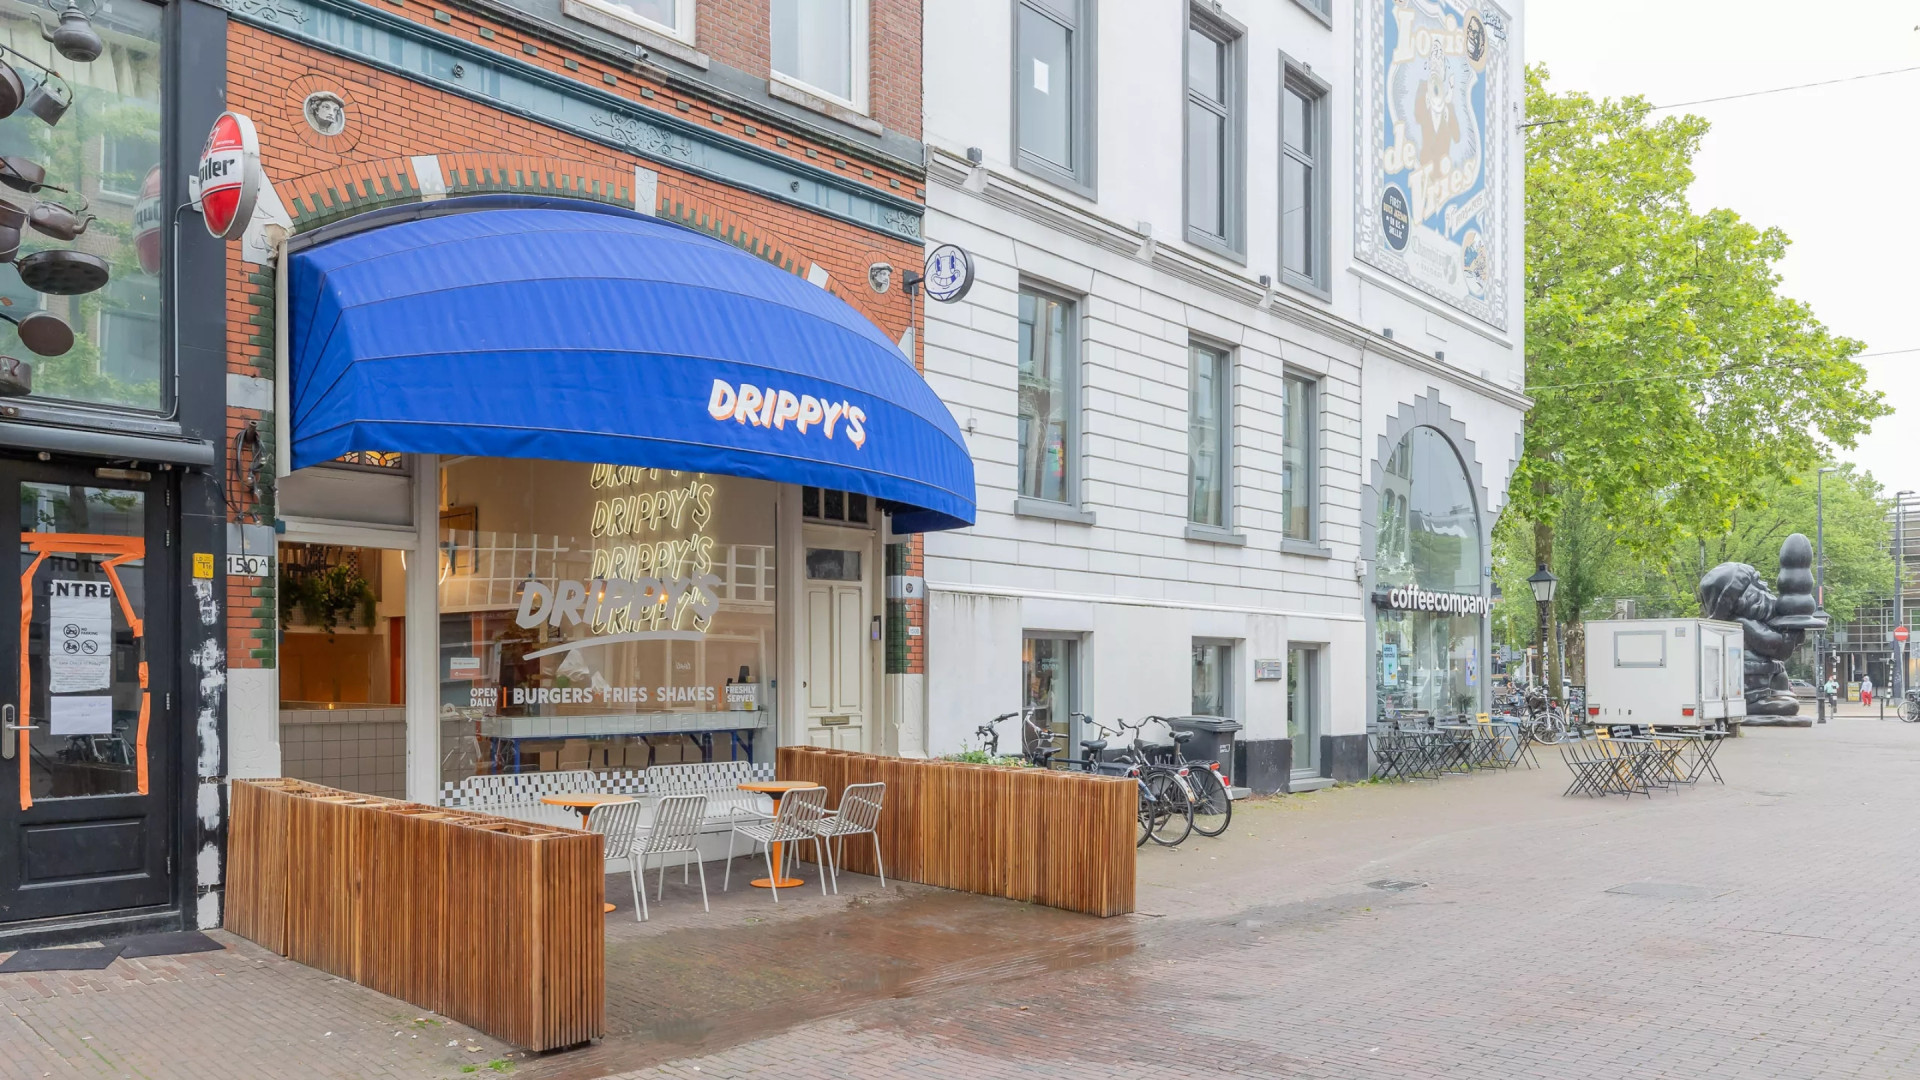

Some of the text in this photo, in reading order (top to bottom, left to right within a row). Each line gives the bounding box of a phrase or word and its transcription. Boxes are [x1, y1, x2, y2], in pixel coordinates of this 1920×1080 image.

[1384, 120, 1417, 174] de
[199, 157, 235, 188] piler
[708, 379, 866, 450] DRIPPY'S
[591, 481, 714, 538] DRIPPY'S
[49, 558, 106, 573] HOTE
[591, 534, 714, 583] DRIPPY'S
[515, 571, 721, 629] DRIPPY'S
[1390, 584, 1490, 618] coffeecompany
[470, 687, 497, 698] OPEN
[470, 697, 497, 707] DAILY
[513, 686, 715, 705] BURGERS FRIES SHAKES
[725, 685, 757, 695] FRESHLY
[726, 693, 755, 703] SERVED
